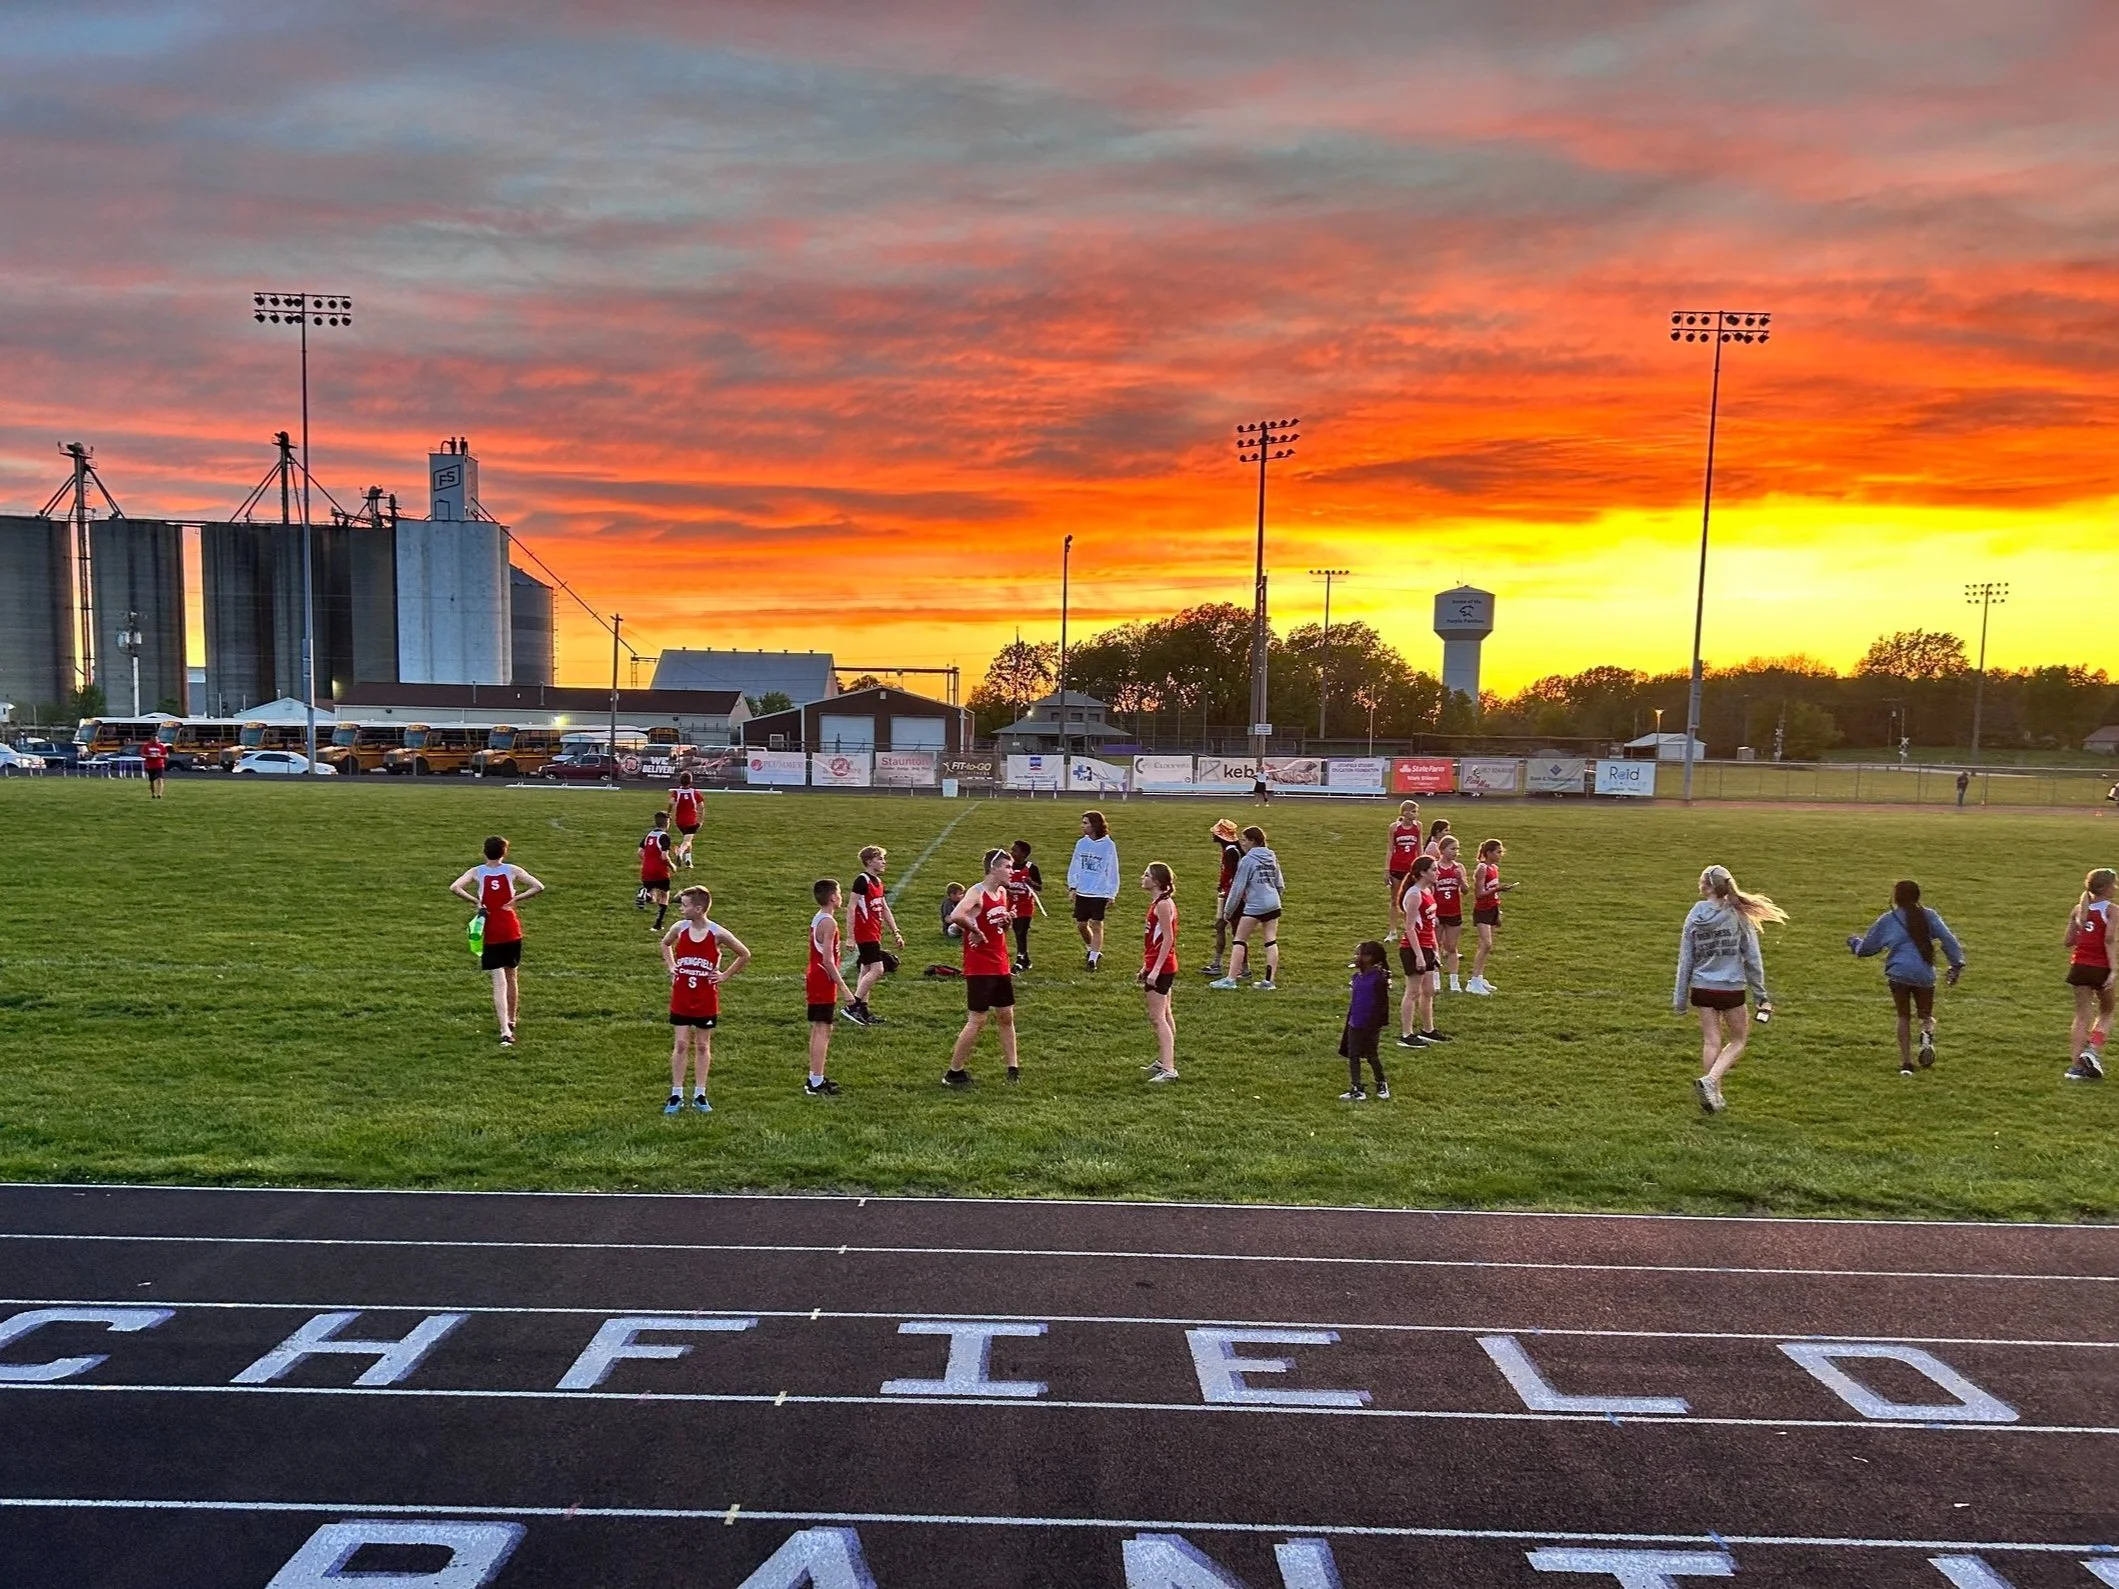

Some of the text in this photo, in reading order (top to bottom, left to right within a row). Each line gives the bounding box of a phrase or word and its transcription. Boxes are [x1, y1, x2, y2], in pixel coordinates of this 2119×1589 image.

[439, 471, 455, 486] FS
[650, 757, 669, 765] WE
[881, 757, 929, 766] Staunton
[1609, 766, 1640, 781] Reid
[490, 879, 500, 891] S
[1444, 892, 1452, 900] S
[2084, 921, 2095, 932] S
[688, 976, 698, 989] S
